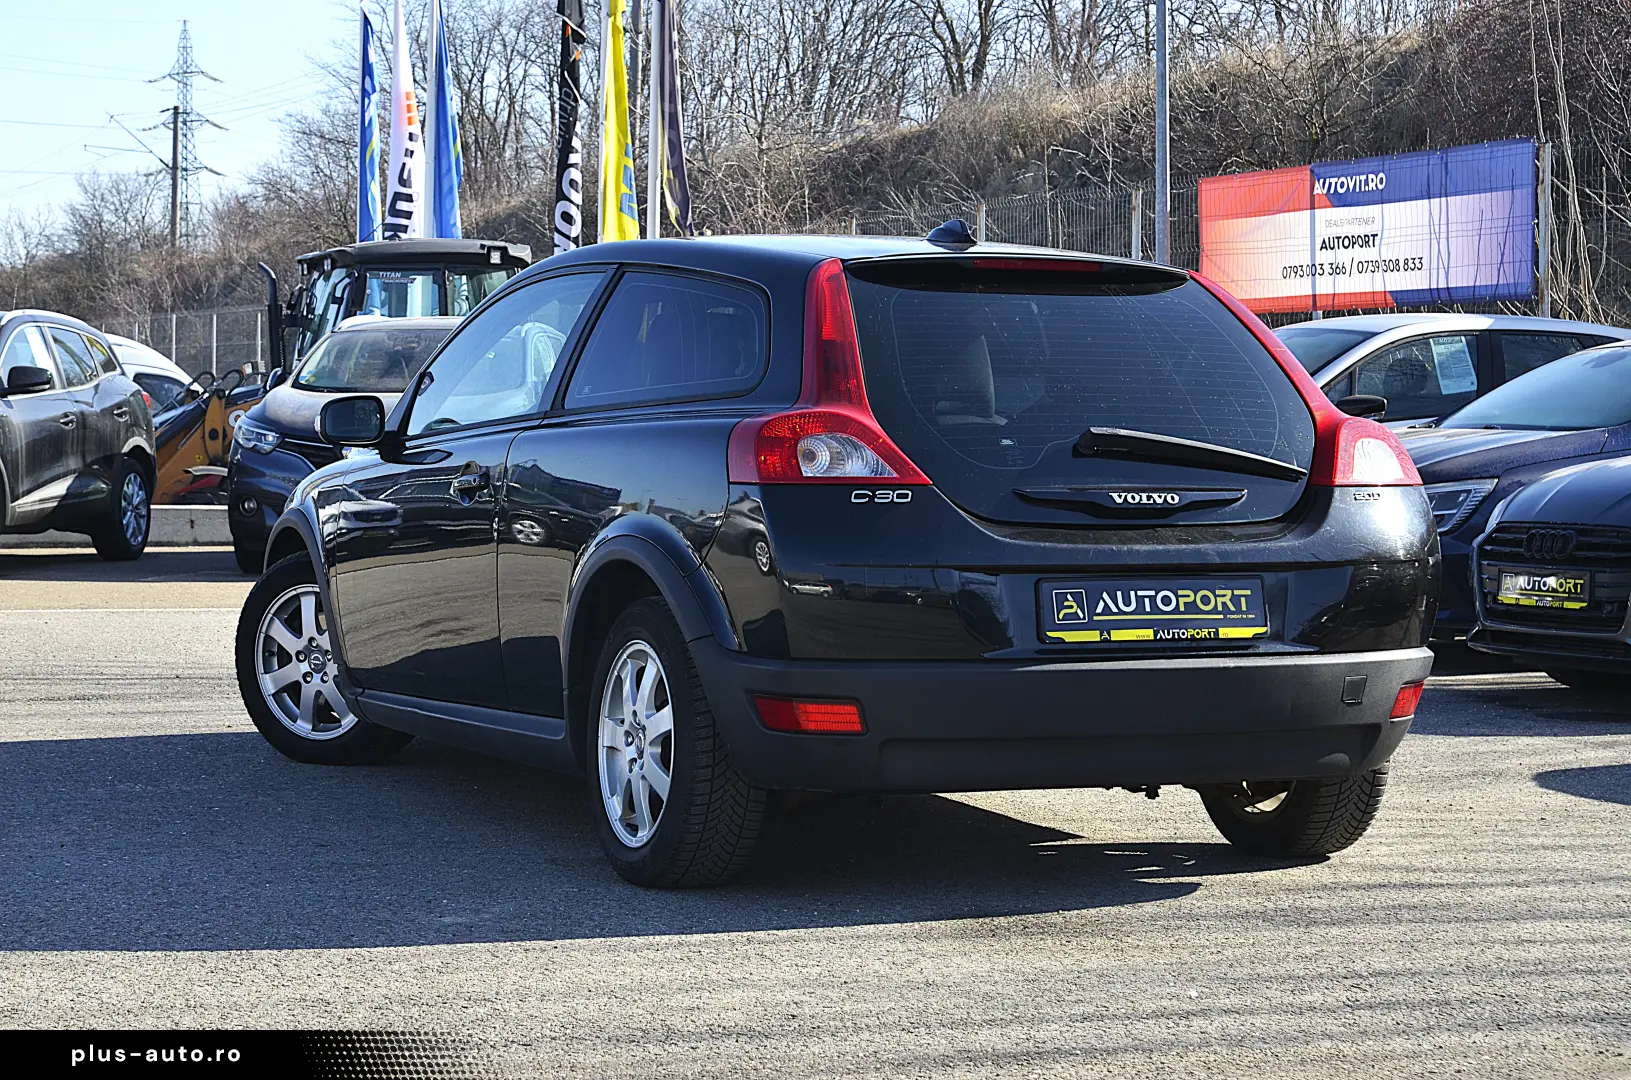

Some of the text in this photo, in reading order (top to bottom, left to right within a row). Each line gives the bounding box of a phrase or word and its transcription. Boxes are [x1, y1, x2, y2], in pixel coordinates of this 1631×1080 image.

[1319, 233, 1379, 251] AUTOPORT
[1282, 265, 1304, 279] 0793
[1305, 263, 1325, 277] 003
[1328, 261, 1347, 276] 366
[1357, 260, 1380, 274] 0739
[1382, 259, 1400, 273] 308
[1403, 257, 1424, 271] 833
[1108, 492, 1180, 504] VOLVO
[1095, 589, 1252, 613] AUTOPORT
[1156, 628, 1216, 640] AUTOPORT
